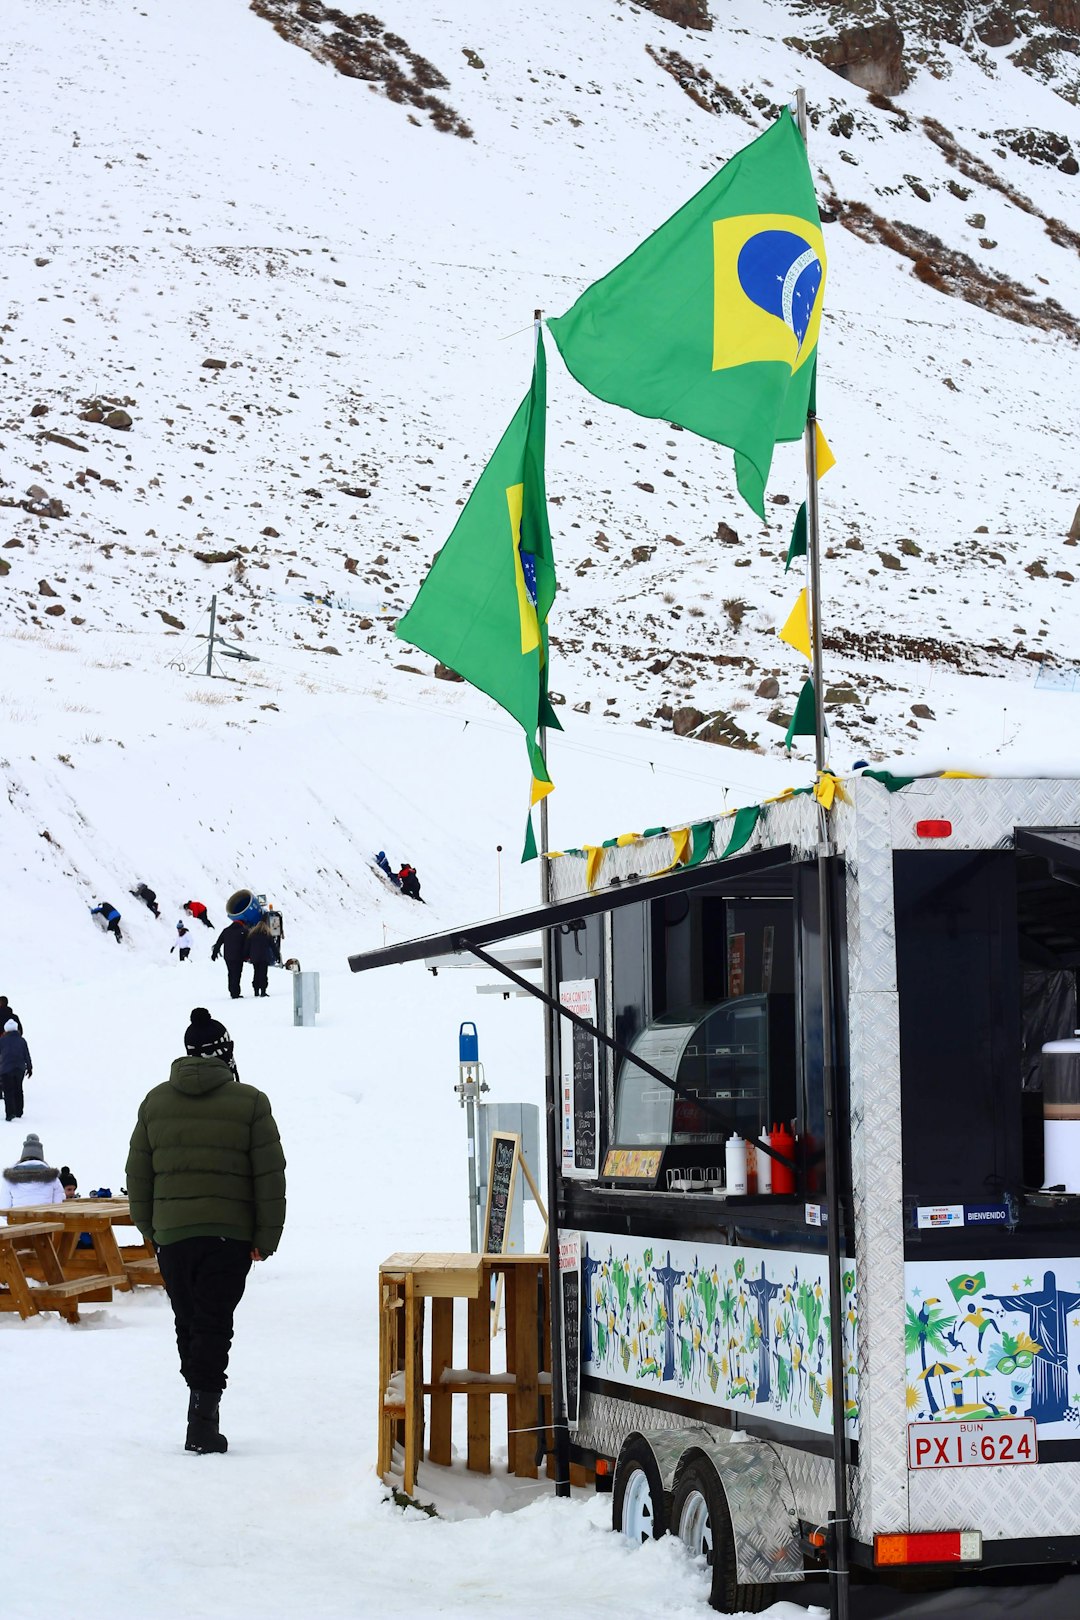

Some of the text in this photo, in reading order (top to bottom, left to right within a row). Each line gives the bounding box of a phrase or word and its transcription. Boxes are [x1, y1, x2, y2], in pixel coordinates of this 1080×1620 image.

[572, 991, 580, 1002] CON
[967, 1211, 1006, 1221] BIENVENIDO
[960, 1424, 984, 1433] BUIN
[981, 1433, 1031, 1461] 624
